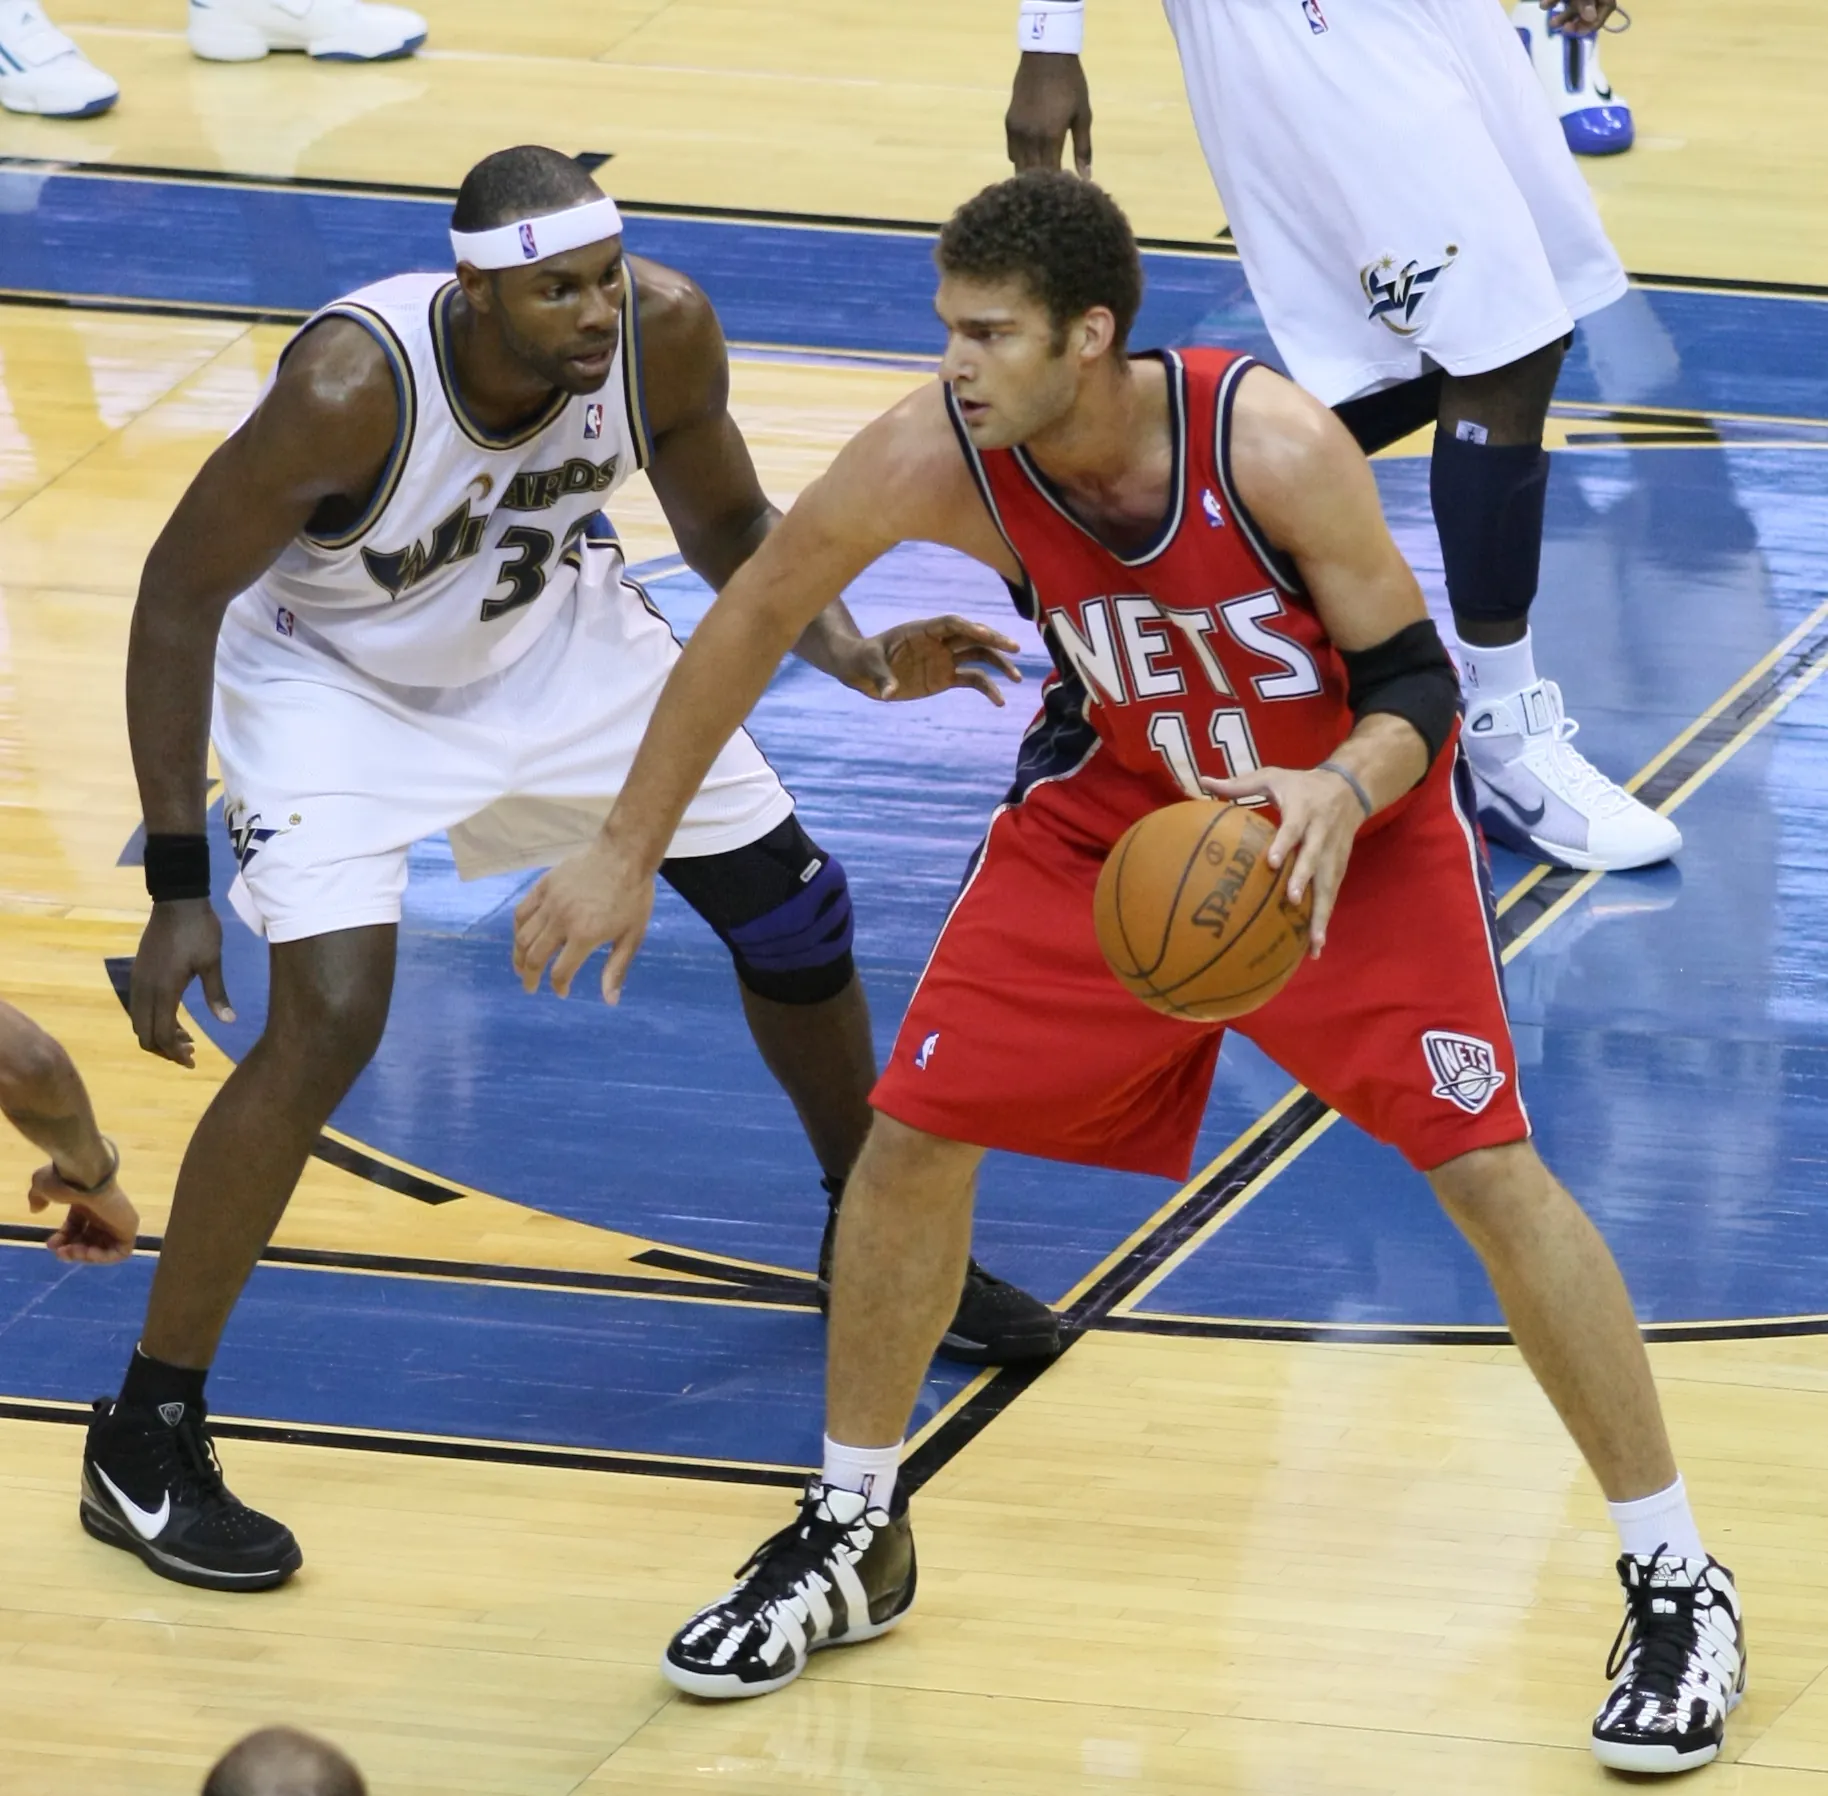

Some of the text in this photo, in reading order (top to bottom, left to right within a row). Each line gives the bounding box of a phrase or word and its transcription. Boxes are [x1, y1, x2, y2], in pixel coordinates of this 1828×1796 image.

[360, 453, 619, 601] WIARDS
[1046, 587, 1325, 708] NETS
[1147, 707, 1272, 809] 11
[1191, 816, 1273, 939] SPALD
[1435, 1039, 1491, 1080] NETS
